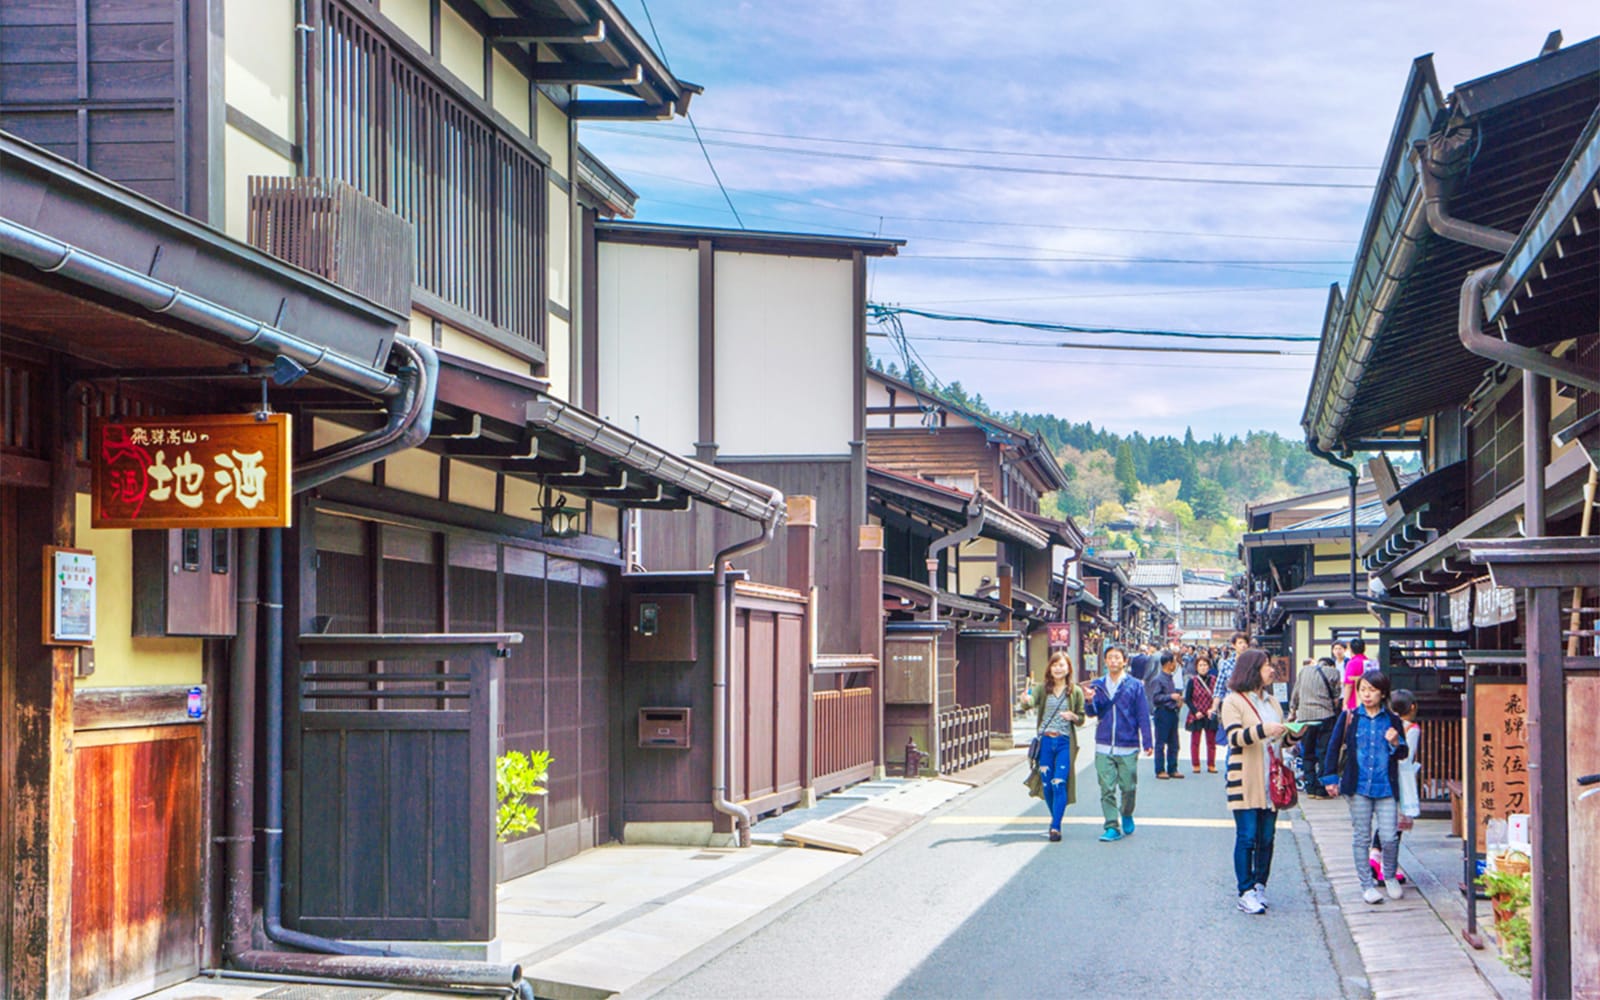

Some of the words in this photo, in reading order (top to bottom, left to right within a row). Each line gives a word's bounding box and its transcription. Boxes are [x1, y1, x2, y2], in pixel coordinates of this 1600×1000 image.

[111, 469, 139, 502] 酒
[147, 450, 267, 509] 地酒
[1503, 694, 1527, 824] 飛騨一位一刀
